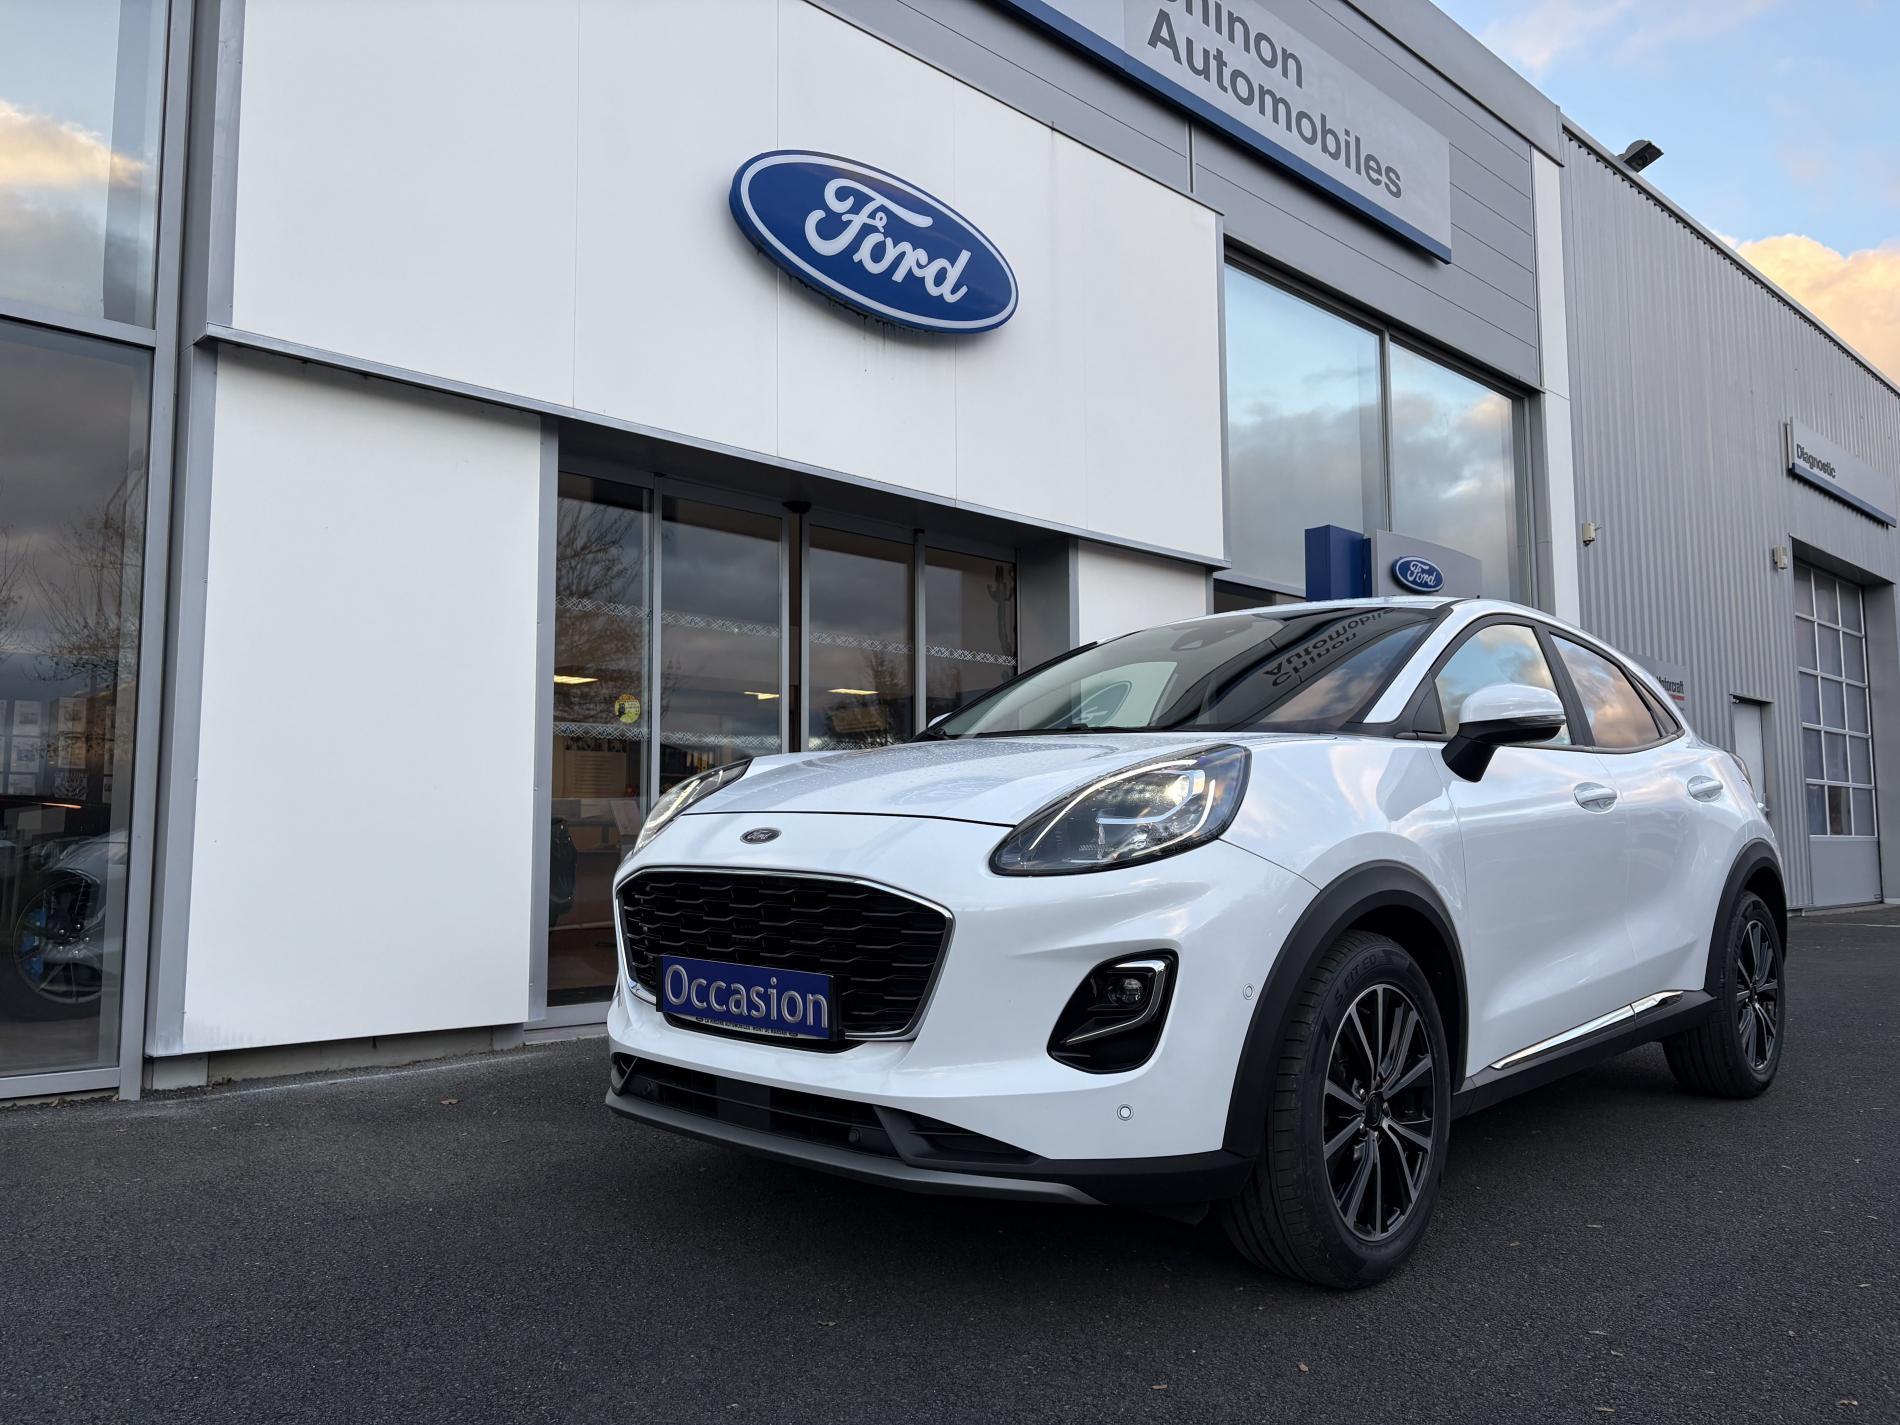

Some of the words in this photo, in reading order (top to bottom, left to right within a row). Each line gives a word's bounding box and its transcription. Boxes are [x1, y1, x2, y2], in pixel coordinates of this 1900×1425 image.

[1147, 8, 1403, 199] Automobiles
[804, 178, 972, 304] Ford
[1796, 443, 1836, 479] Diagnostic
[1406, 560, 1437, 586] Ford
[664, 964, 829, 1030] Occasion
